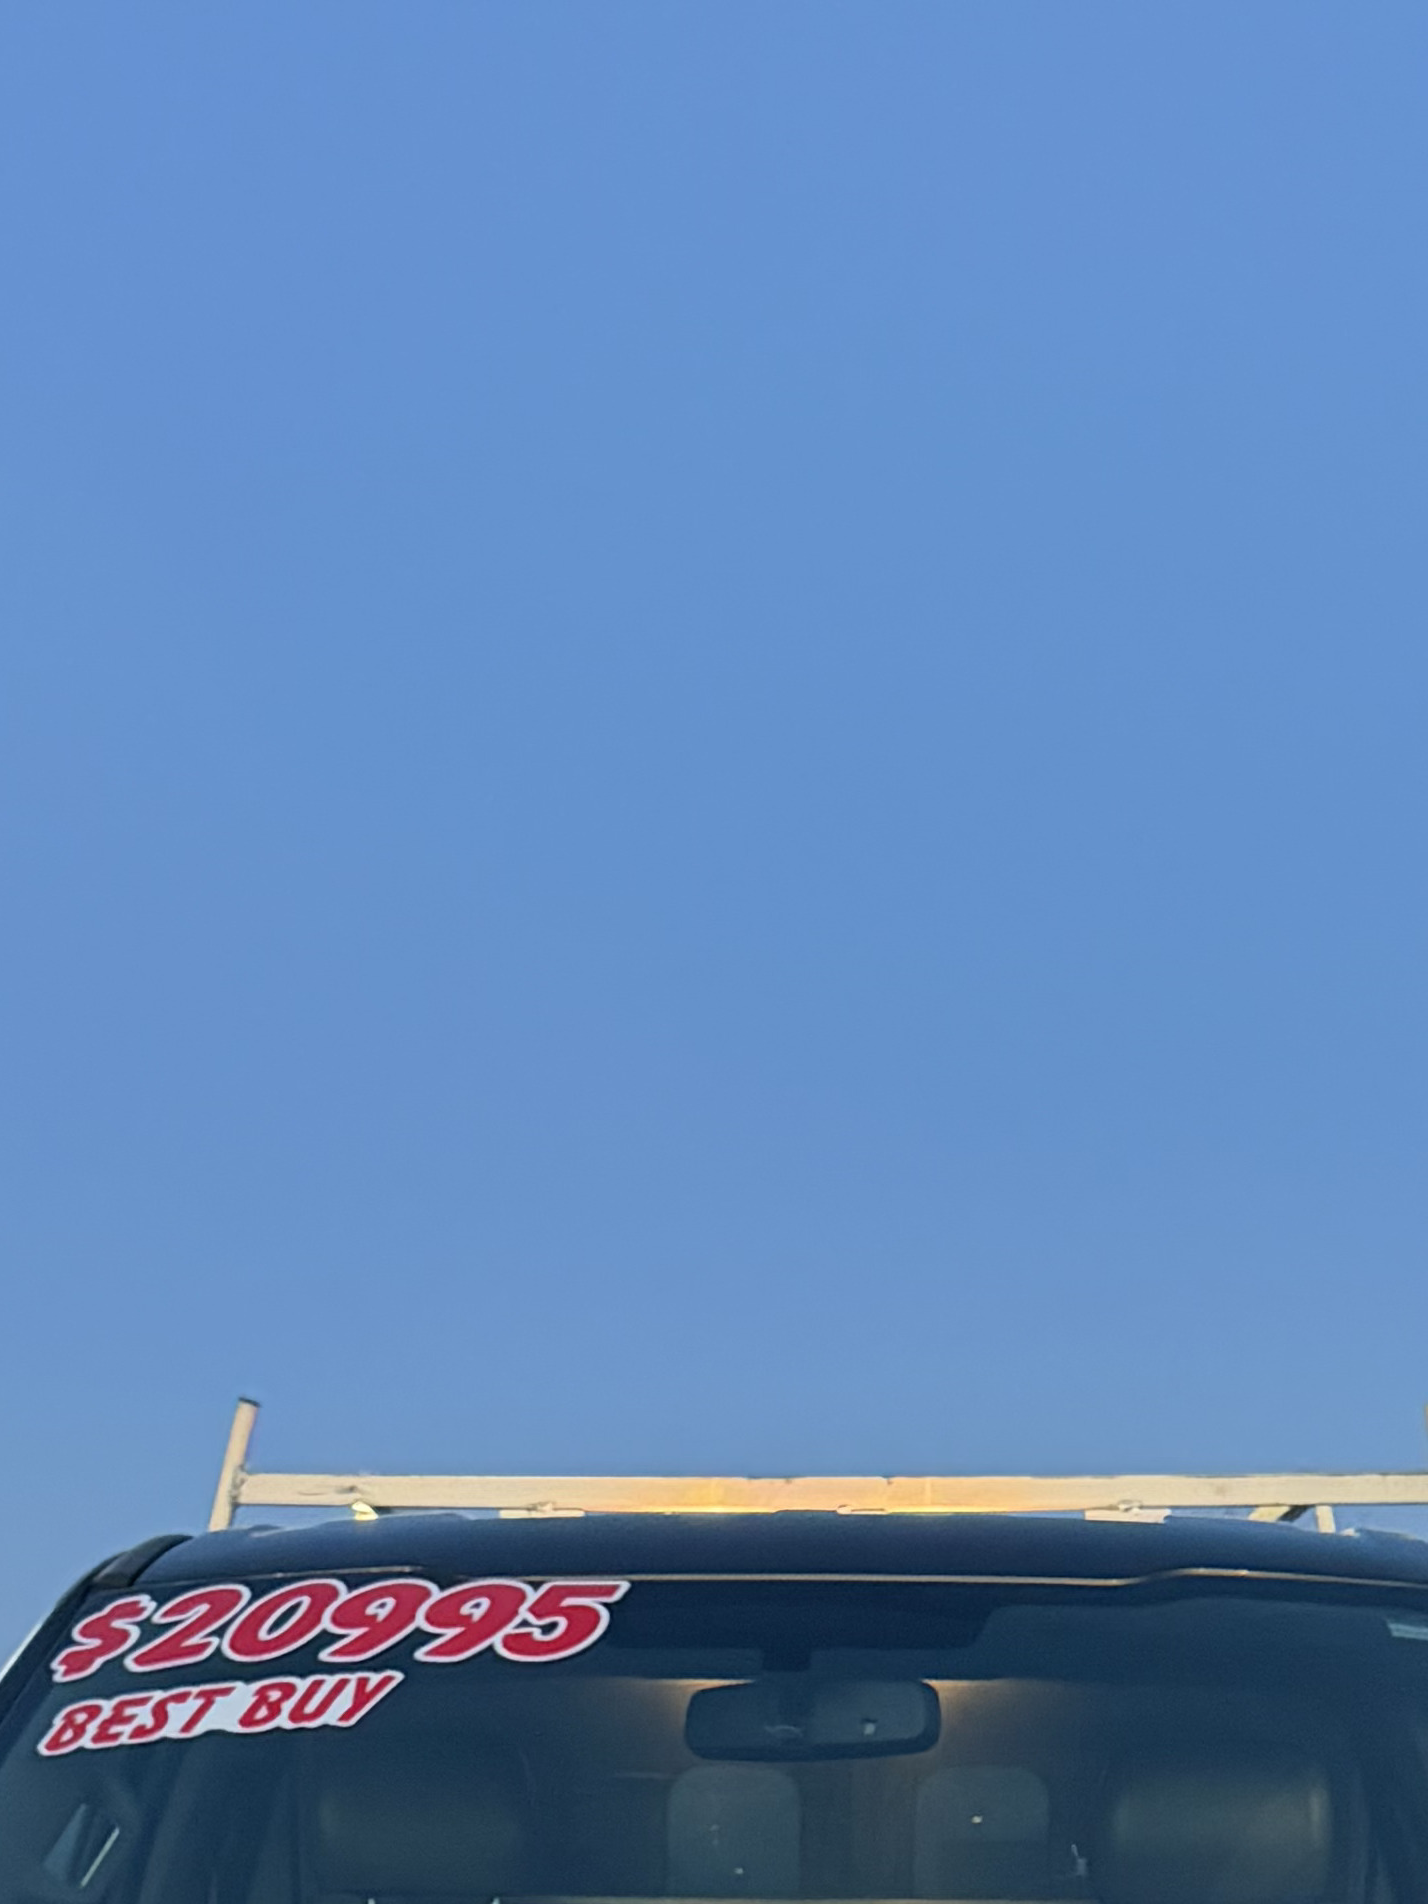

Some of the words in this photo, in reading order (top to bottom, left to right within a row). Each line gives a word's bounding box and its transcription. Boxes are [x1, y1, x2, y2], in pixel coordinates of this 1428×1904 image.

[53, 1579, 630, 1682] $20995
[38, 1686, 235, 1756] BEST
[237, 1671, 404, 1734] BUY
